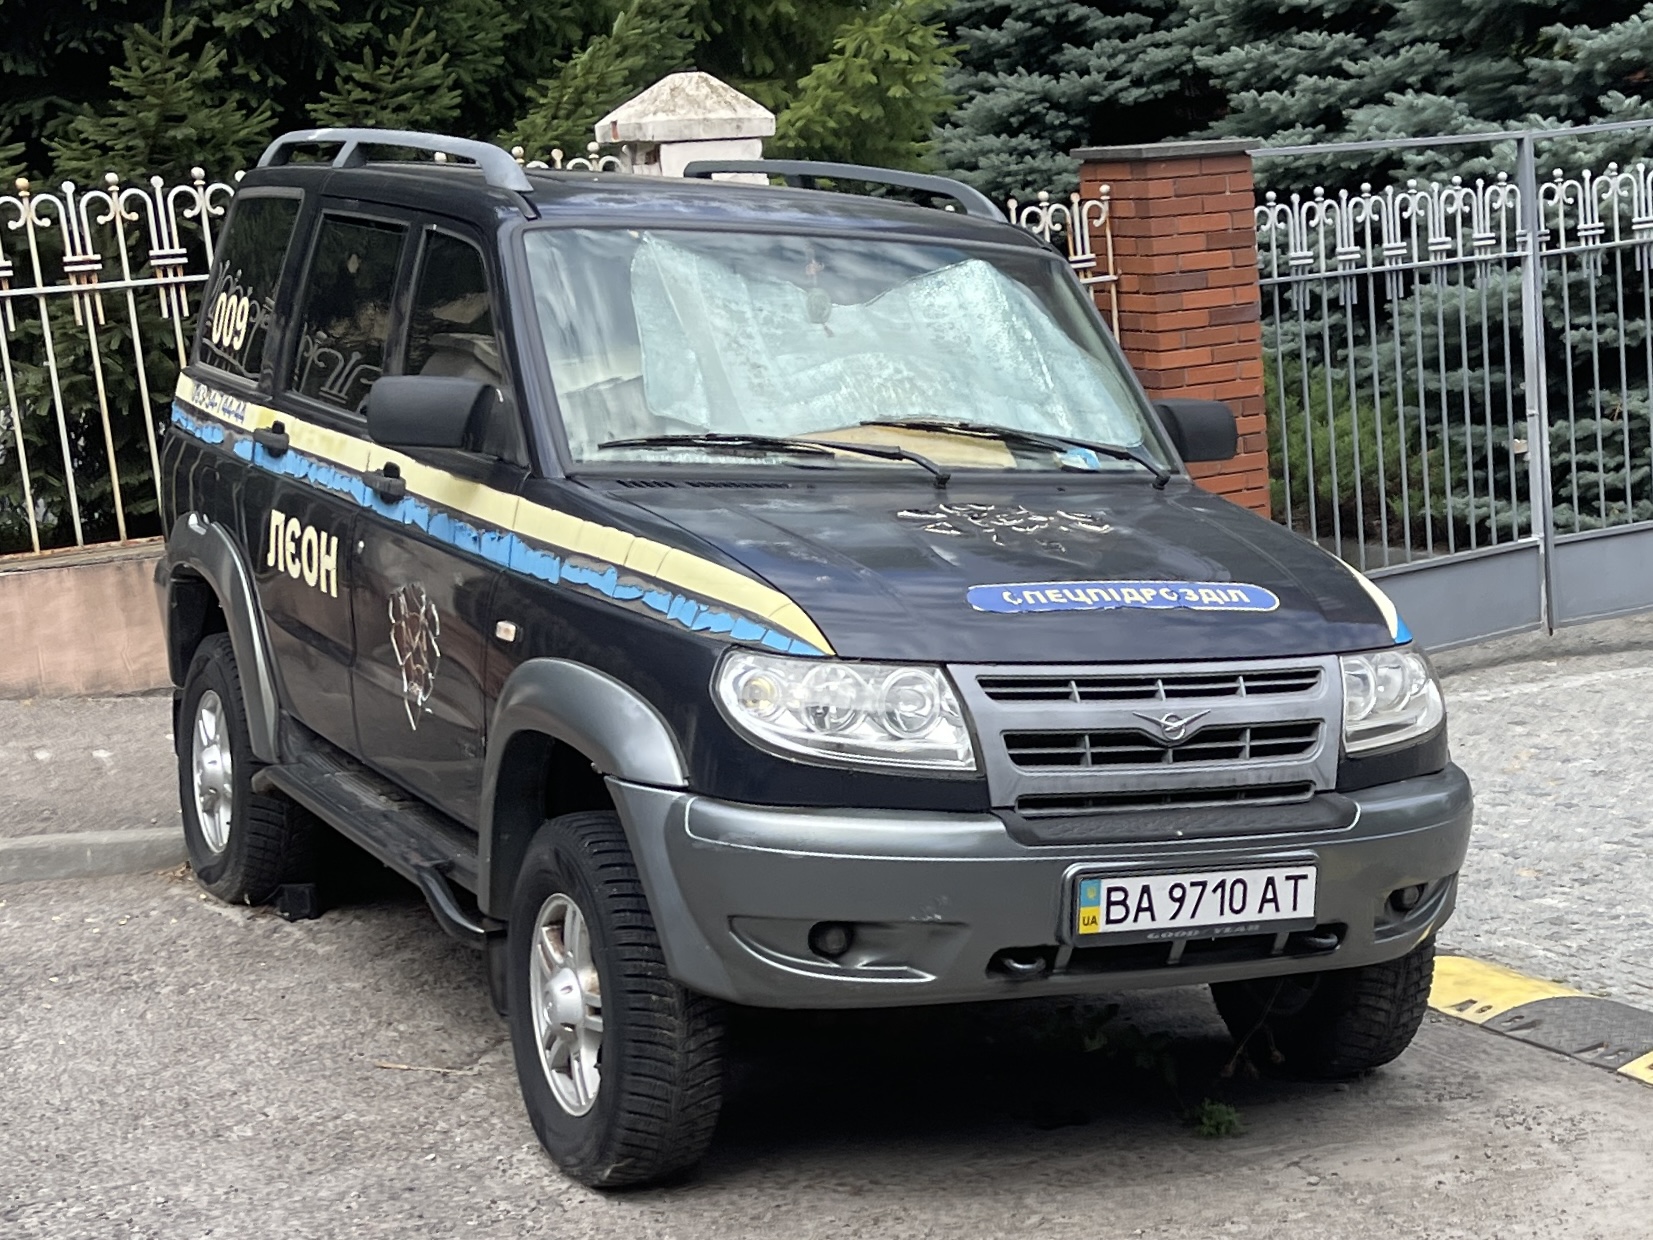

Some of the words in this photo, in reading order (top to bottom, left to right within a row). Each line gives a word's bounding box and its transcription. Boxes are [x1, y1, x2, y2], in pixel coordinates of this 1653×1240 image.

[212, 291, 250, 351] 009
[267, 509, 339, 598] ЛЄОН
[1001, 586, 1252, 606] СПЕЦПІДРОЗДІЛ
[1082, 916, 1099, 927] UA
[1105, 884, 1157, 926] BA
[1168, 877, 1248, 921] 9710
[1257, 874, 1309, 914] AT
